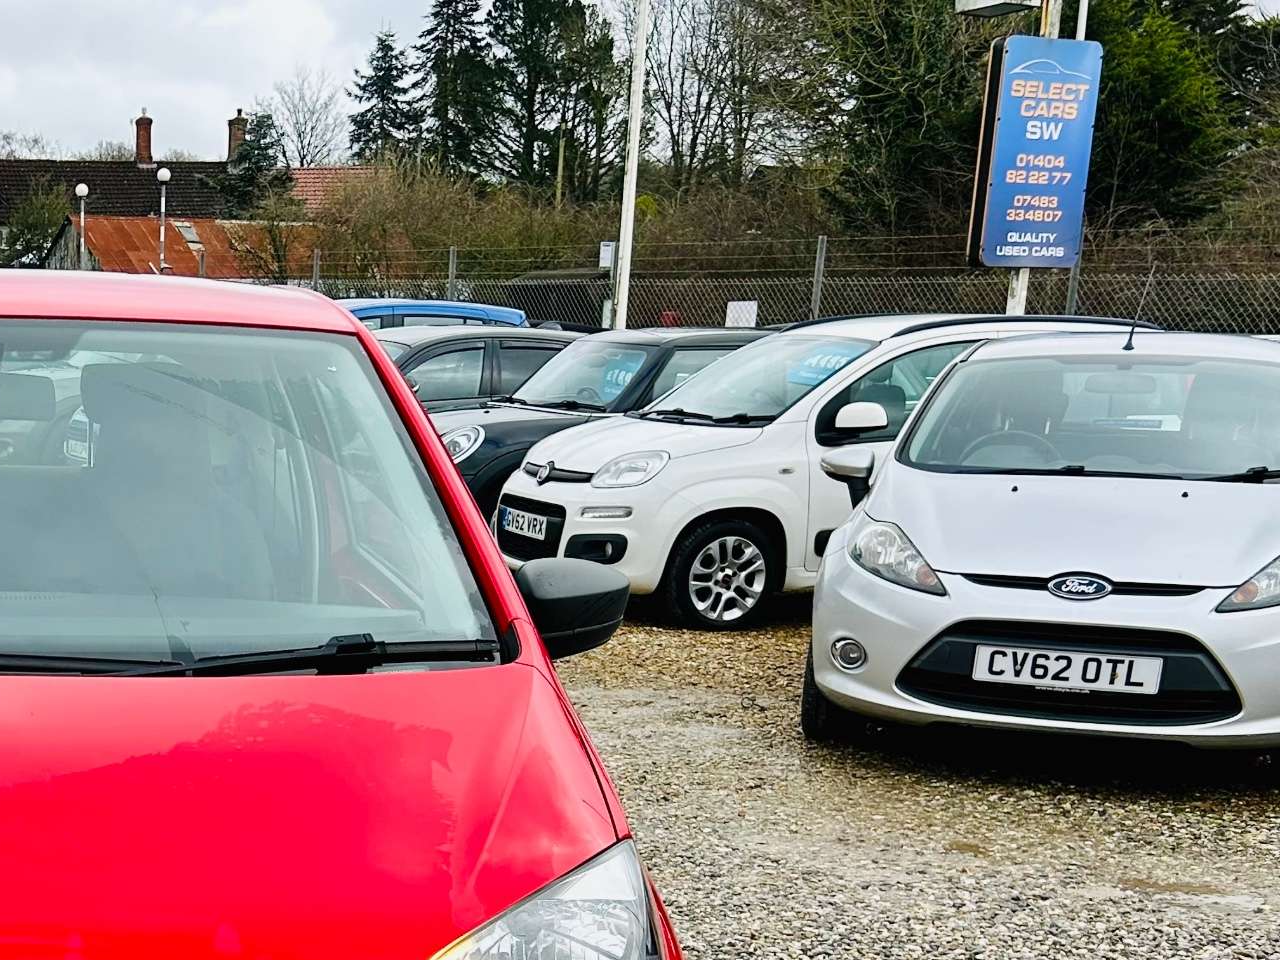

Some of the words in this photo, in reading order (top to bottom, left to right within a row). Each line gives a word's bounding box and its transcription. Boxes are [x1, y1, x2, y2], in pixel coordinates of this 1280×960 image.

[1011, 80, 1090, 101] SELECT
[1020, 100, 1078, 120] CARS
[1025, 121, 1063, 140] SW
[1016, 153, 1065, 169] 01404
[1014, 195, 1059, 208] 07483
[1006, 209, 1063, 222] 334807
[1007, 231, 1057, 243] QUALITY
[996, 245, 1029, 256] USED
[1031, 246, 1064, 257] CARS
[527, 515, 544, 536] VRX
[1061, 578, 1098, 594] Ford
[987, 650, 1073, 682] CV62
[1081, 657, 1145, 688] OTL
